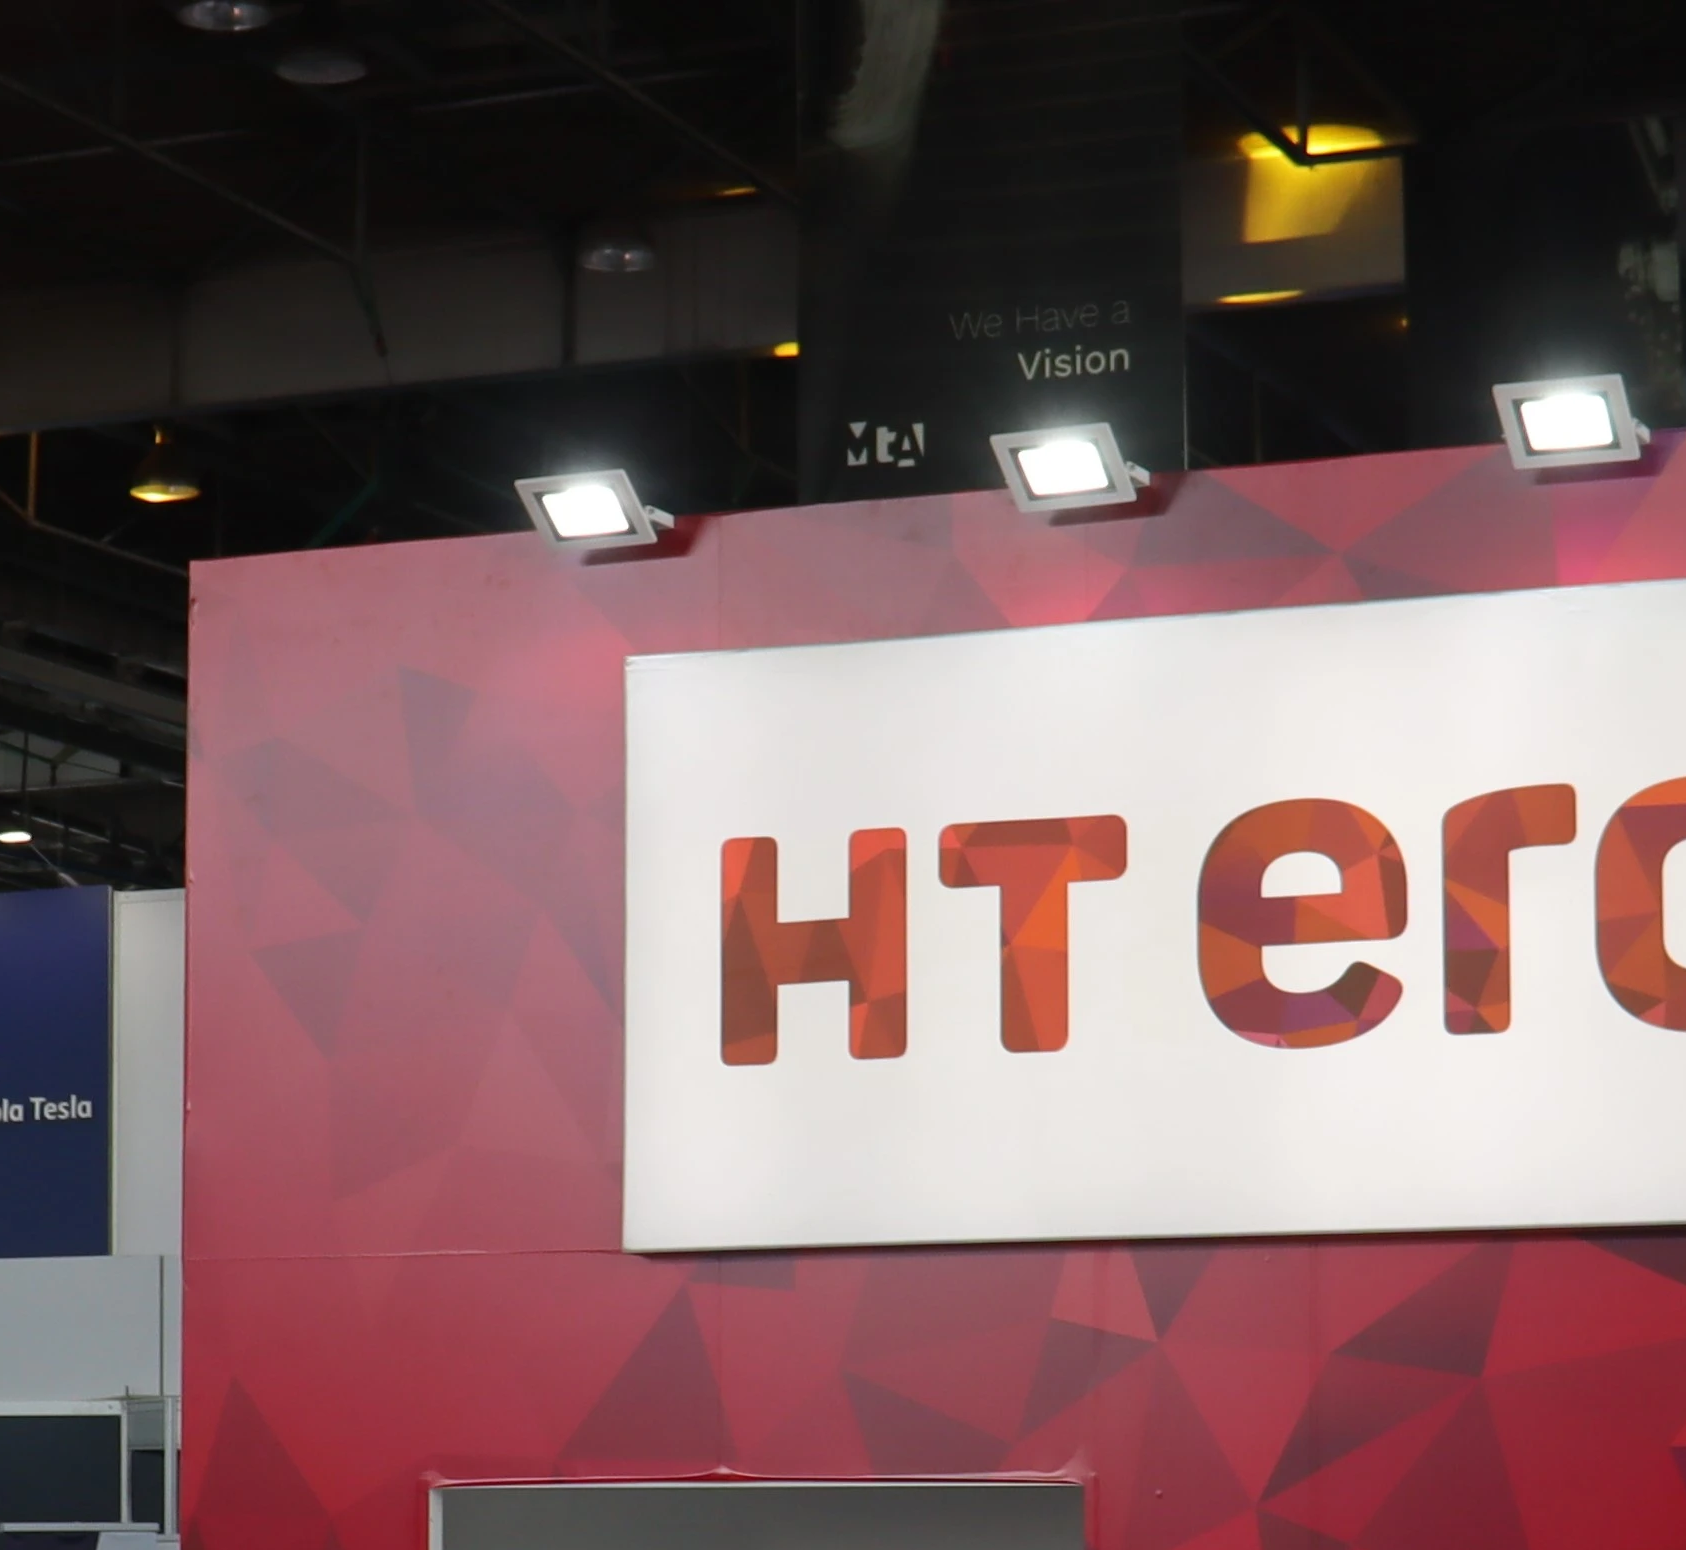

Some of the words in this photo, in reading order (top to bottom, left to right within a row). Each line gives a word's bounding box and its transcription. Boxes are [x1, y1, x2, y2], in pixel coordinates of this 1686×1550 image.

[1017, 345, 1130, 381] Vision
[718, 812, 1129, 1065] HT
[28, 1094, 93, 1121] Tesla
